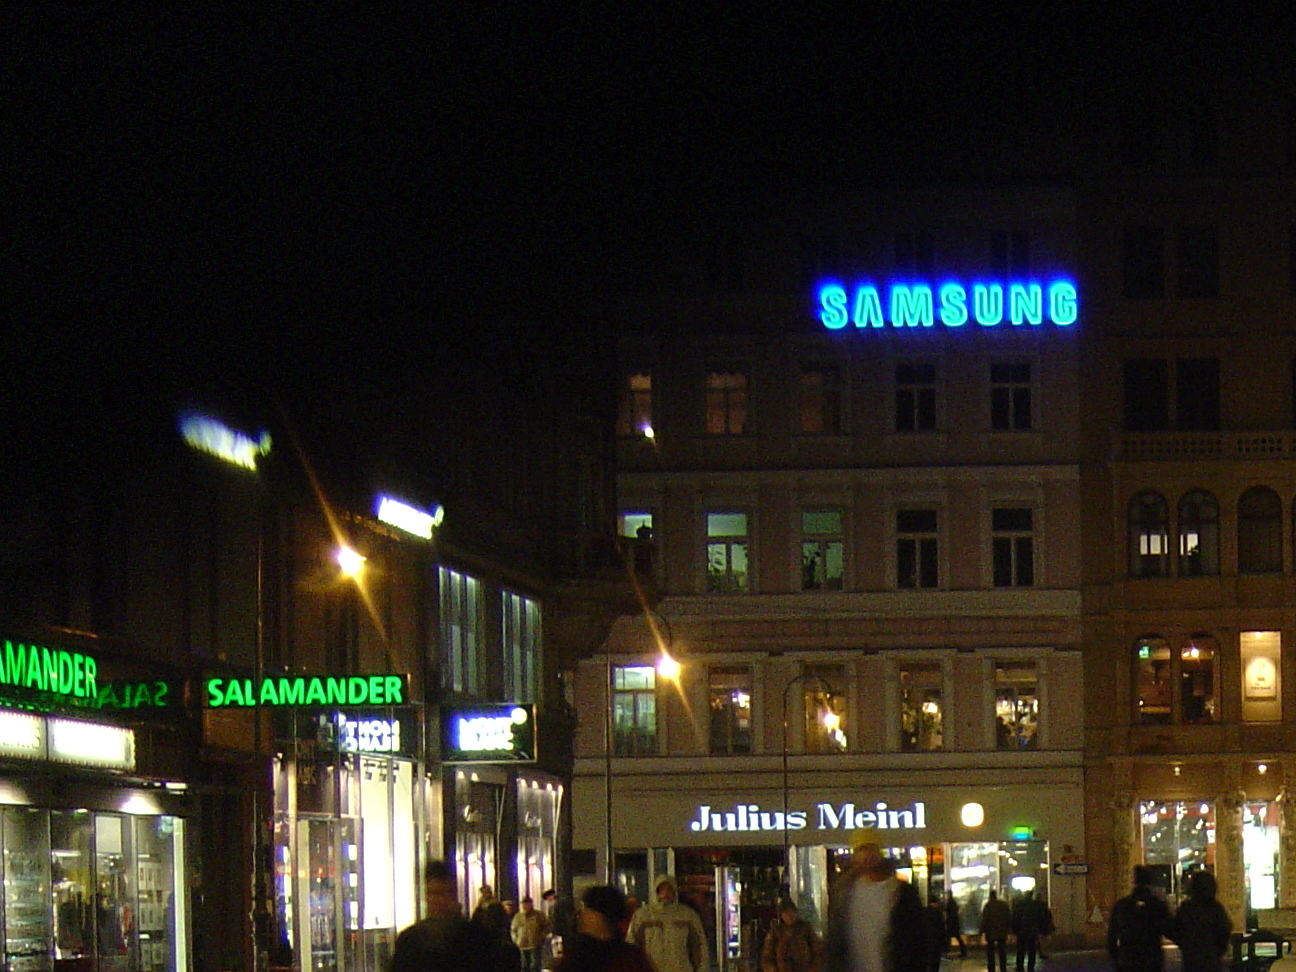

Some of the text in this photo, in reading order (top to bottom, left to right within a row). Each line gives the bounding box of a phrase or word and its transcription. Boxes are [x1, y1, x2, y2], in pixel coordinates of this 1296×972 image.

[819, 282, 1079, 330] SAMSUNG
[208, 676, 403, 707] SALAMANDER
[691, 802, 926, 831] Julius Meinl
